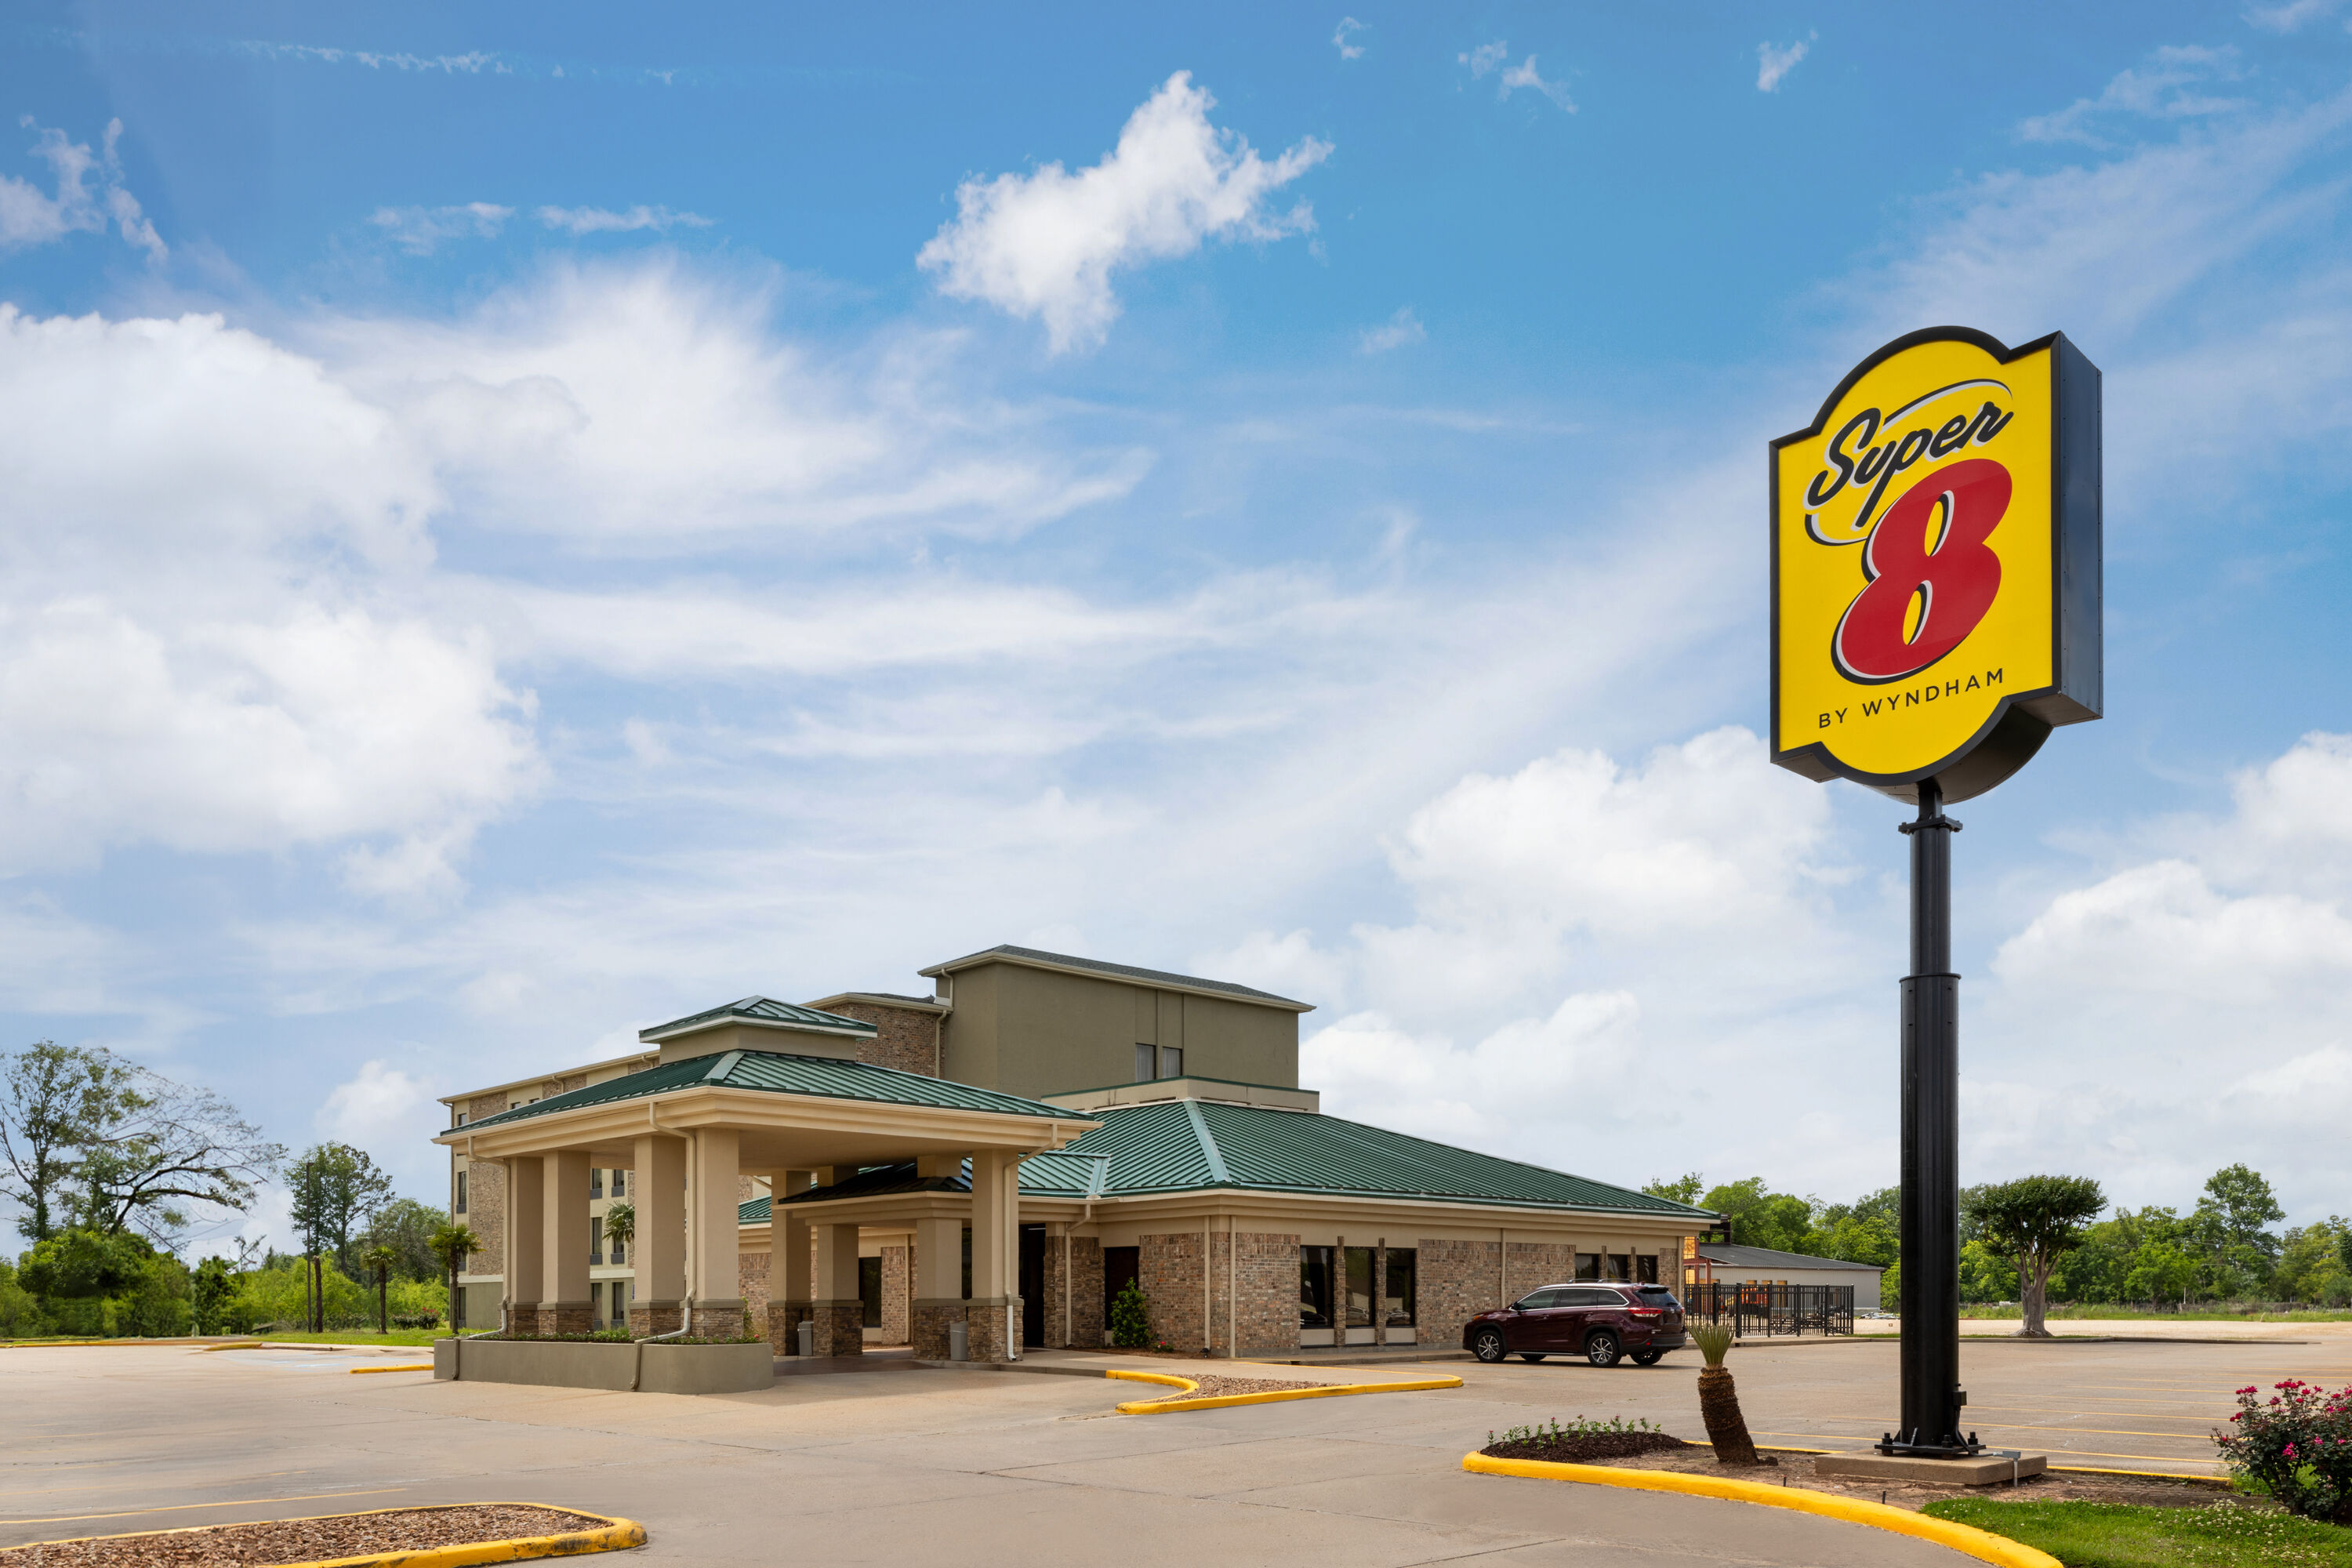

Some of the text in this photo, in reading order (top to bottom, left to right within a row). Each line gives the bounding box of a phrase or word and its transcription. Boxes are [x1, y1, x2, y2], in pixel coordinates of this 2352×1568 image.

[1804, 401, 2014, 531] Super
[1831, 459, 2013, 684] 8
[1819, 668, 2002, 728] BY WYNDHAM
